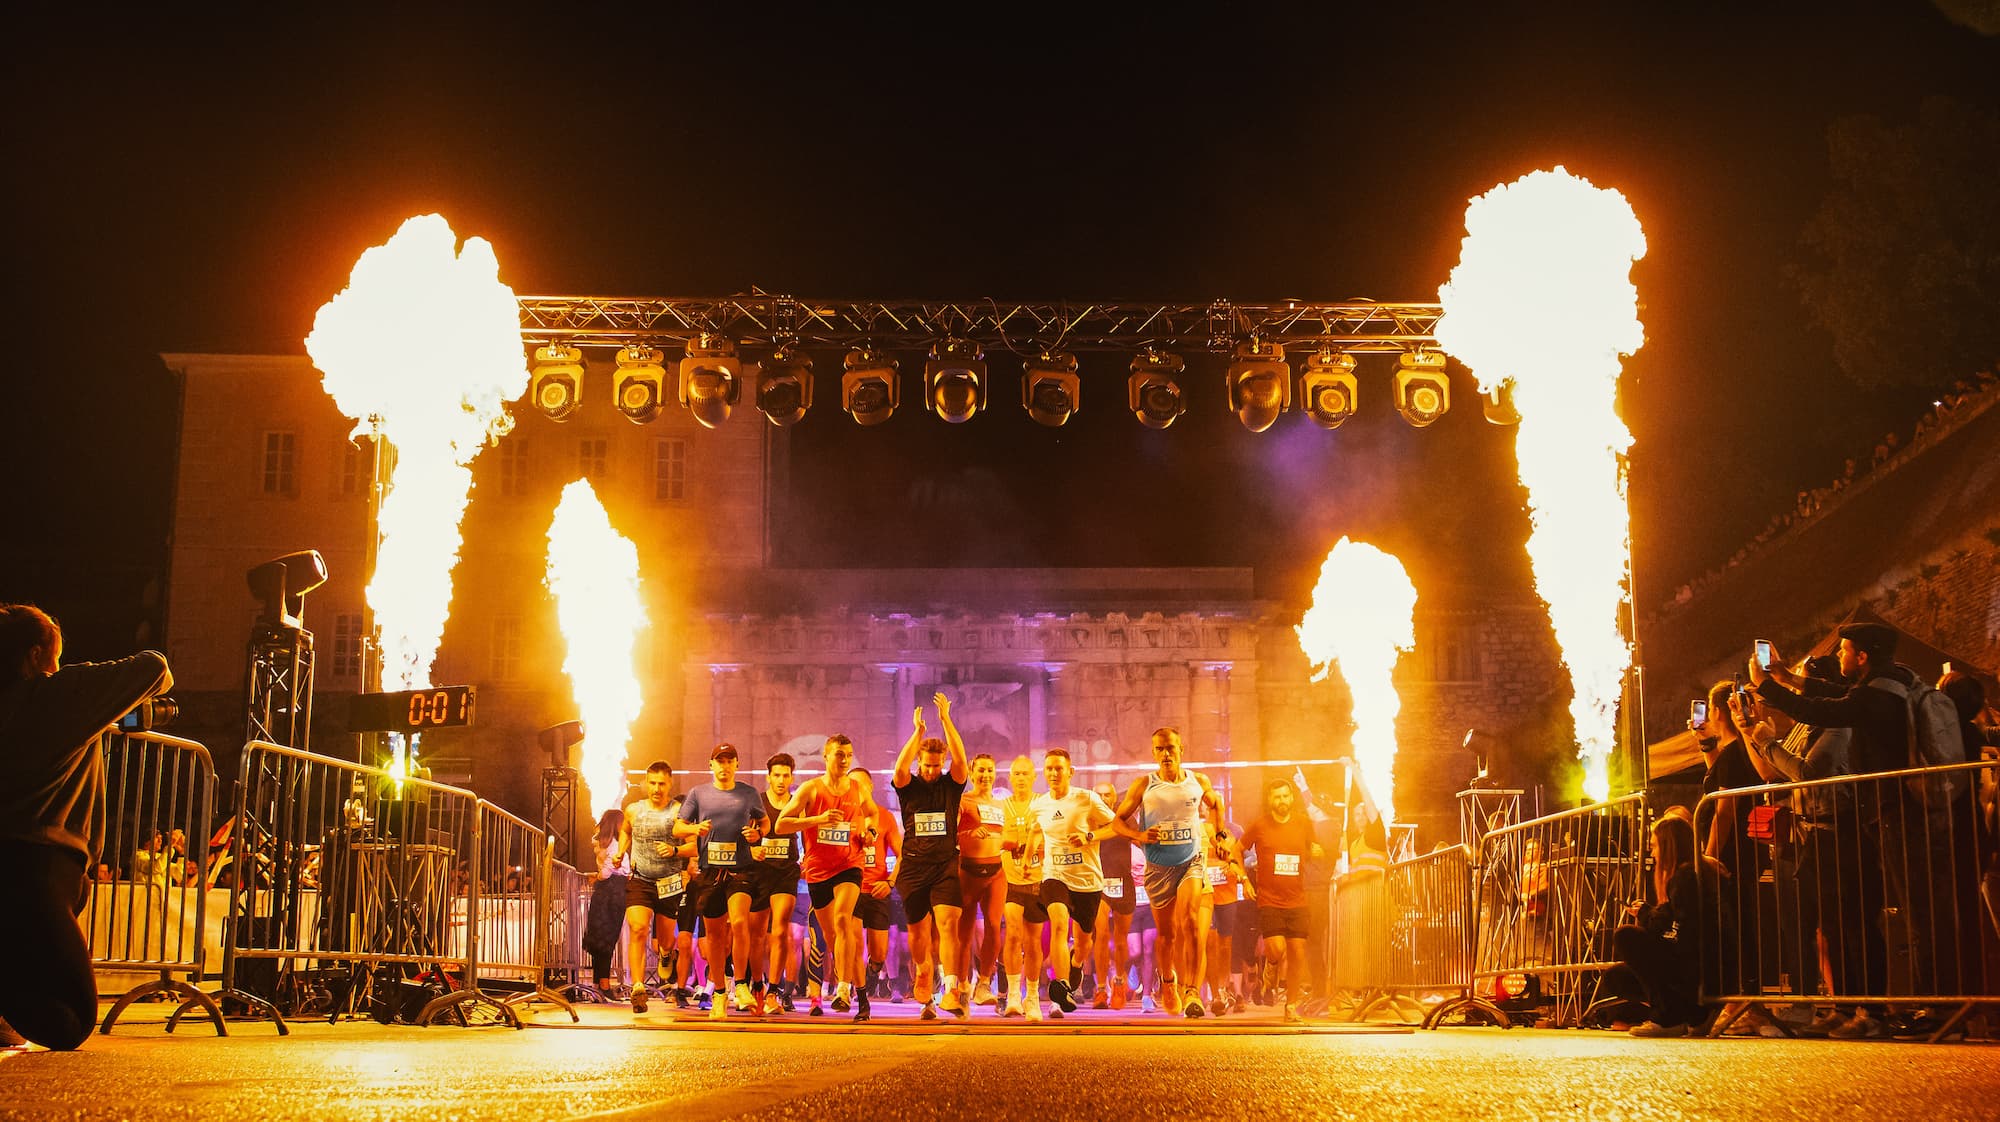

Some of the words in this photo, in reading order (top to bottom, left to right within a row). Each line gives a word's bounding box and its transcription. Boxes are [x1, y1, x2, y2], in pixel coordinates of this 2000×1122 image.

[408, 692, 467, 726] 0:01
[916, 822, 945, 832] 0189
[819, 829, 848, 841] 0101
[1161, 829, 1190, 841] 0130
[709, 851, 736, 861] 0107
[1053, 853, 1082, 865] 0235
[1208, 873, 1227, 883] 254
[659, 881, 682, 895] 0178
